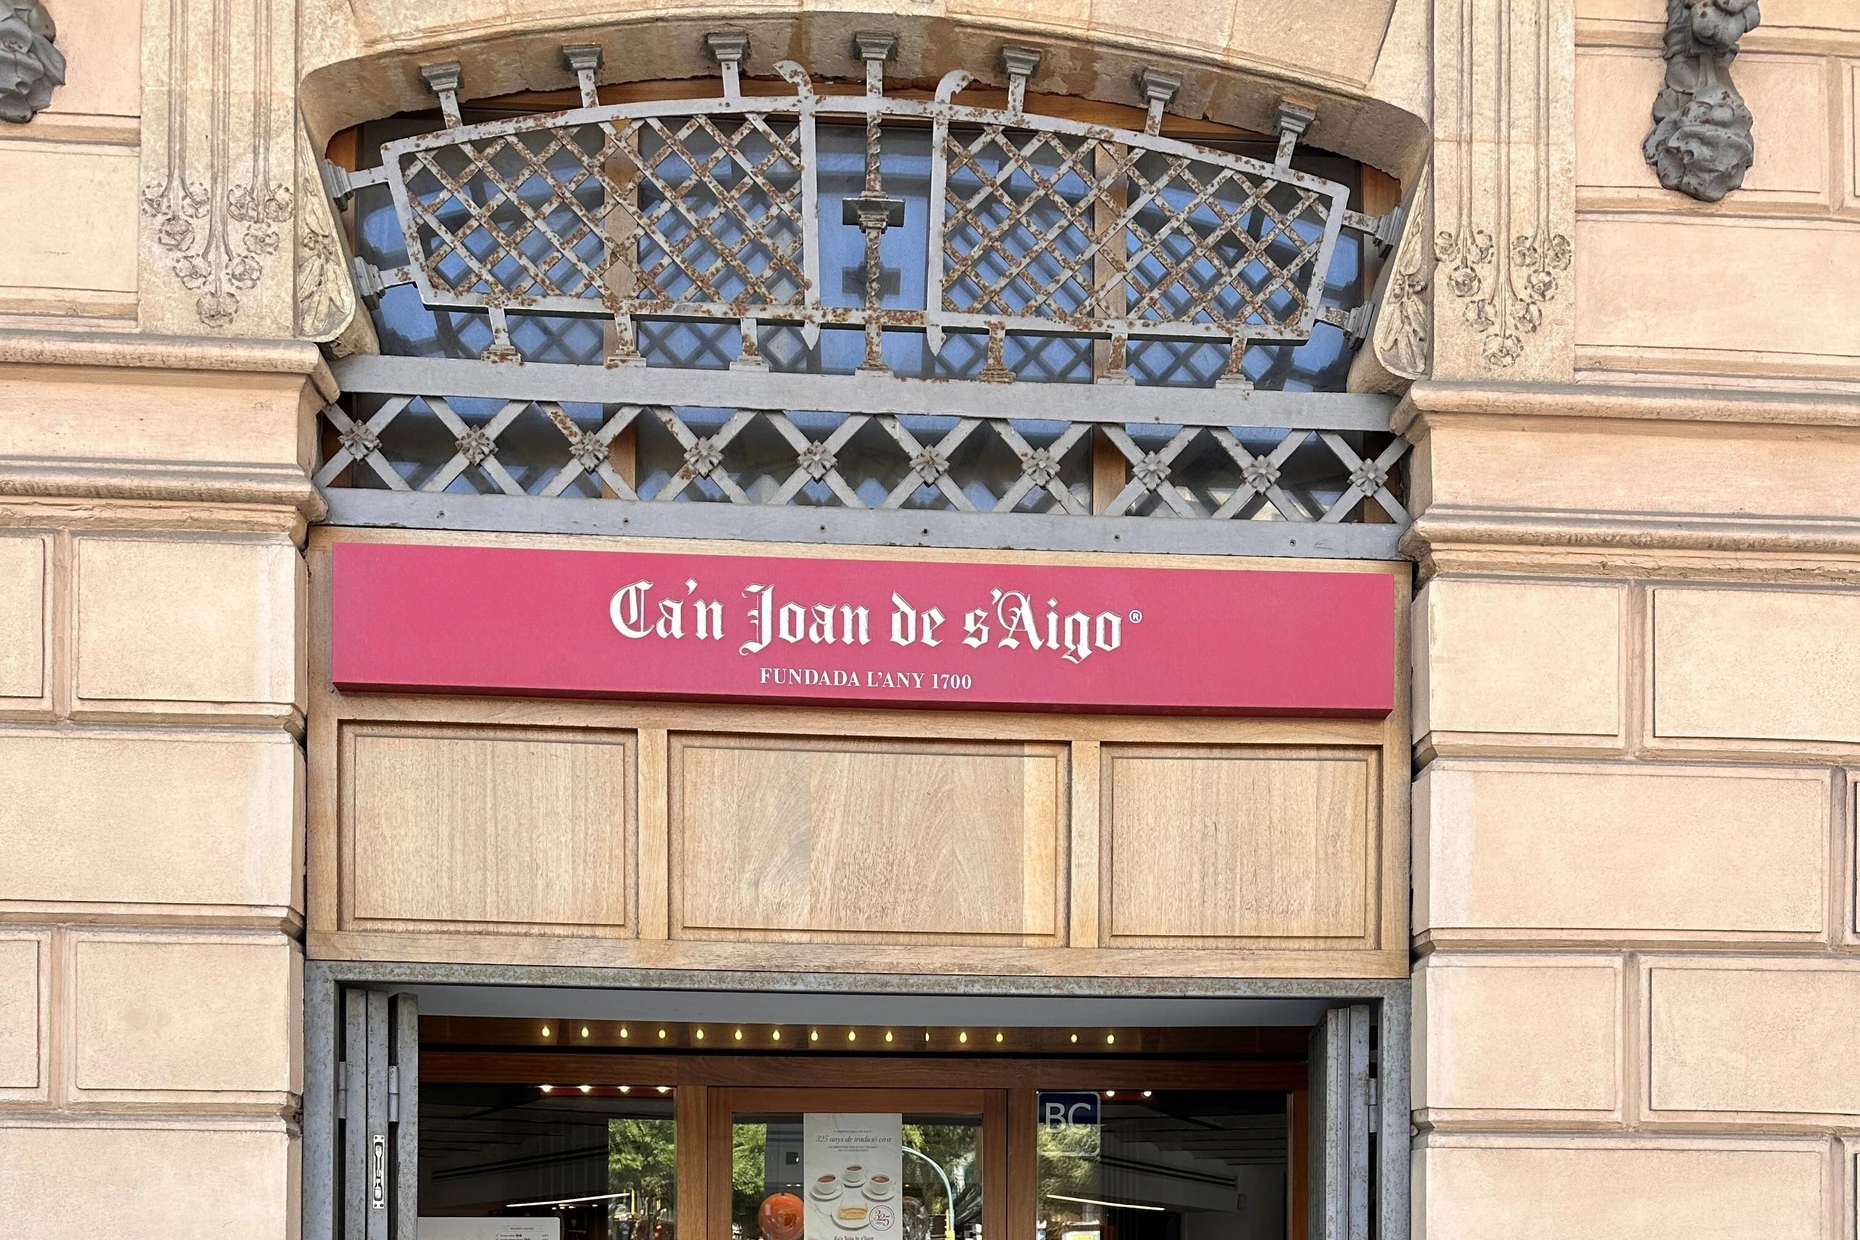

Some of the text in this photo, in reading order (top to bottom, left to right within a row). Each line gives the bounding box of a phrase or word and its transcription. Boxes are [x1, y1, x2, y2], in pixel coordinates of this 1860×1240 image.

[609, 578, 725, 640] Ca'n
[738, 583, 871, 656] Joan
[889, 590, 945, 648] de
[759, 667, 972, 690] FUNDADA L'ANY 1700
[1045, 1102, 1092, 1133] BC
